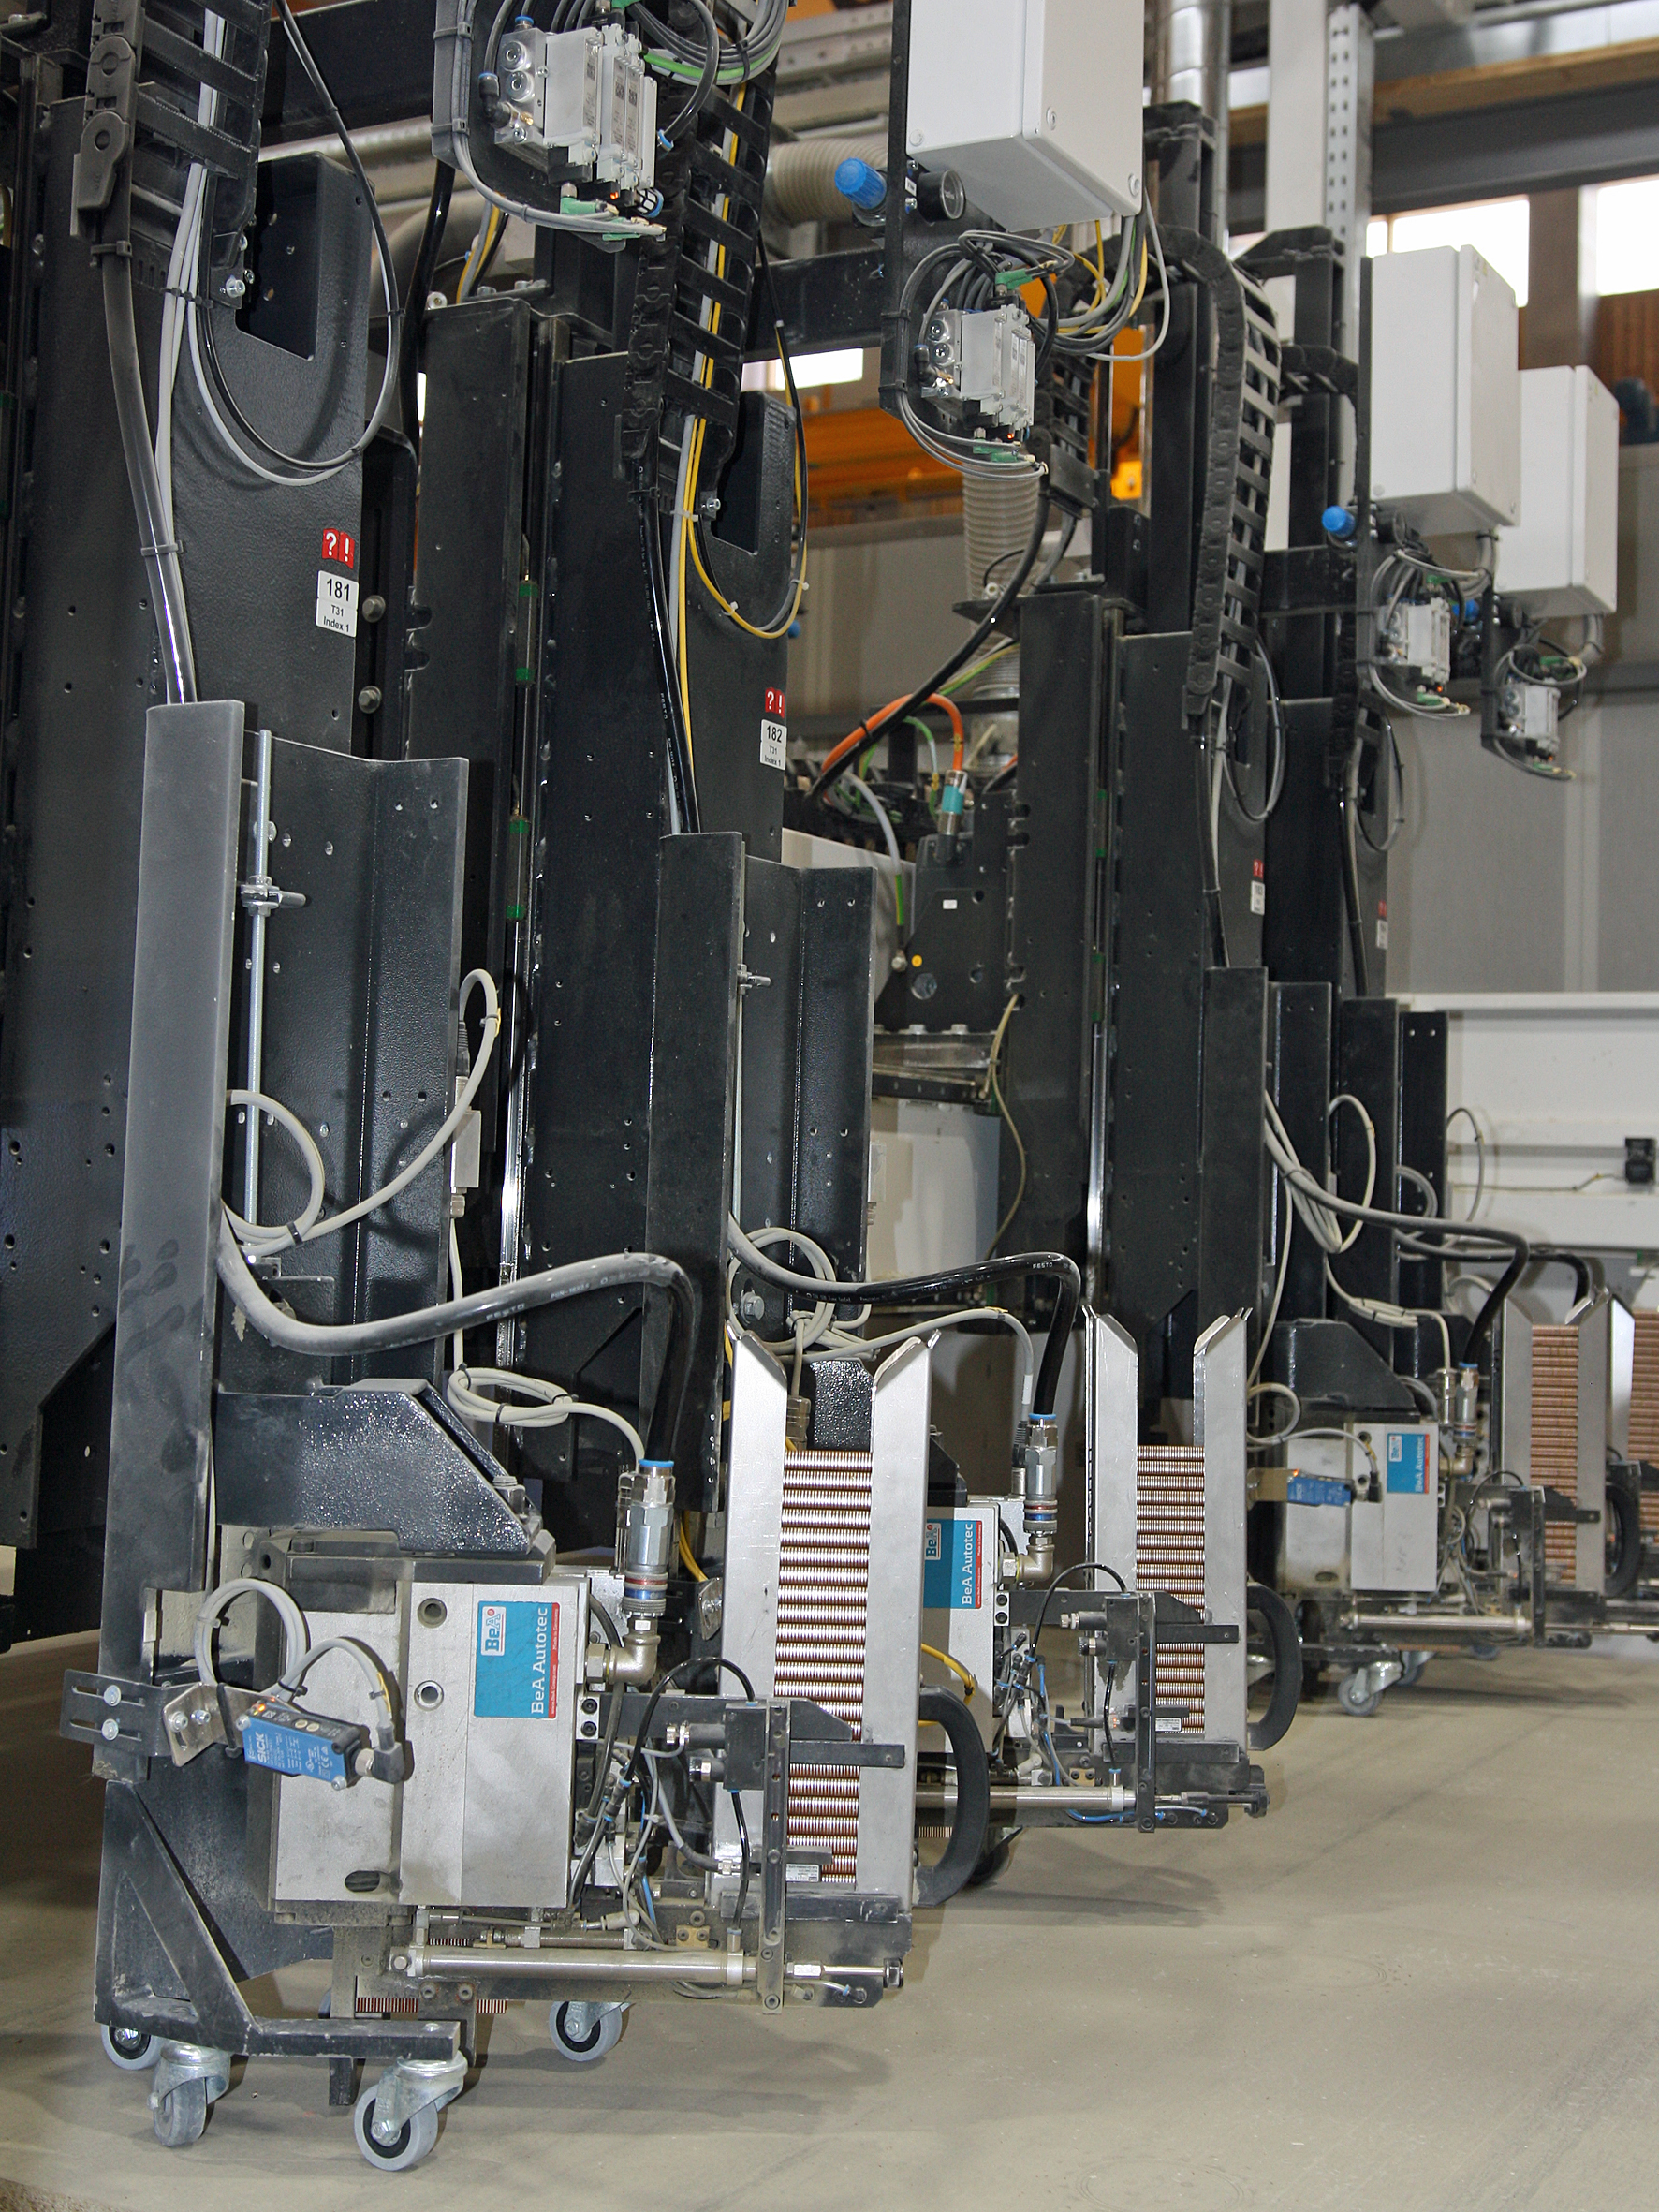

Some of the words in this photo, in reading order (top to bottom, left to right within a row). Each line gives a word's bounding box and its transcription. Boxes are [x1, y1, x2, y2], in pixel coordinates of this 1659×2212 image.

[327, 578, 349, 601] 181
[323, 616, 344, 630] Index
[345, 624, 349, 632] 1
[331, 605, 344, 616] T31
[767, 725, 783, 743] 182
[925, 1527, 937, 1557] BeA
[962, 1523, 974, 1574] Autotec
[962, 1576, 973, 1605] BeA
[485, 1613, 501, 1652] BeA
[532, 1607, 548, 1674] Autotec
[531, 1677, 545, 1714] BeA
[255, 1732, 267, 1762] SICK
